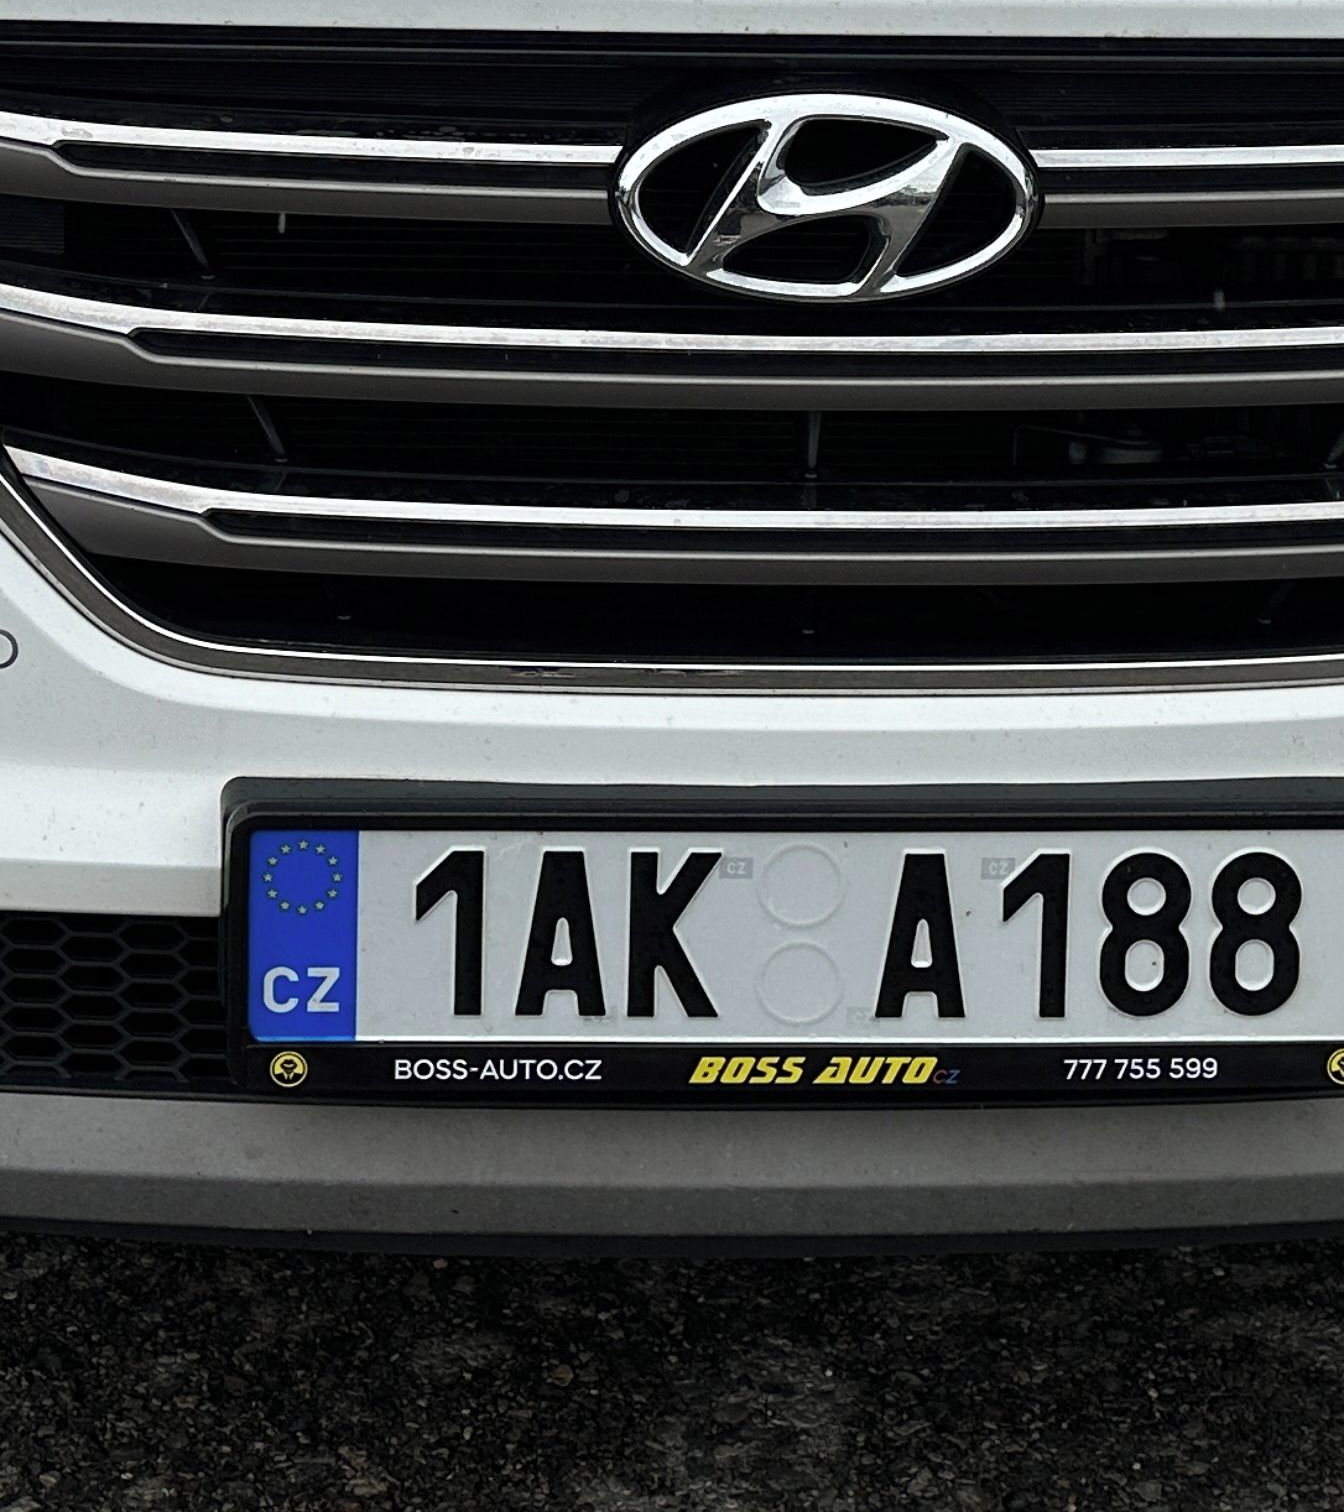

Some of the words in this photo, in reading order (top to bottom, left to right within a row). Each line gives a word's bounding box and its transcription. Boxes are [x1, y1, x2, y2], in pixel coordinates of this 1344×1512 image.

[414, 849, 724, 1018] 1AK
[874, 849, 1303, 1019] A188
[262, 965, 341, 1013] CZ
[394, 1058, 603, 1081] BOSS-AUTO.CZ
[688, 1056, 806, 1084] BOSS
[812, 1056, 938, 1084] AUTO
[1063, 1058, 1107, 1080] 777
[1114, 1057, 1161, 1080] 755
[1169, 1057, 1218, 1080] 599
